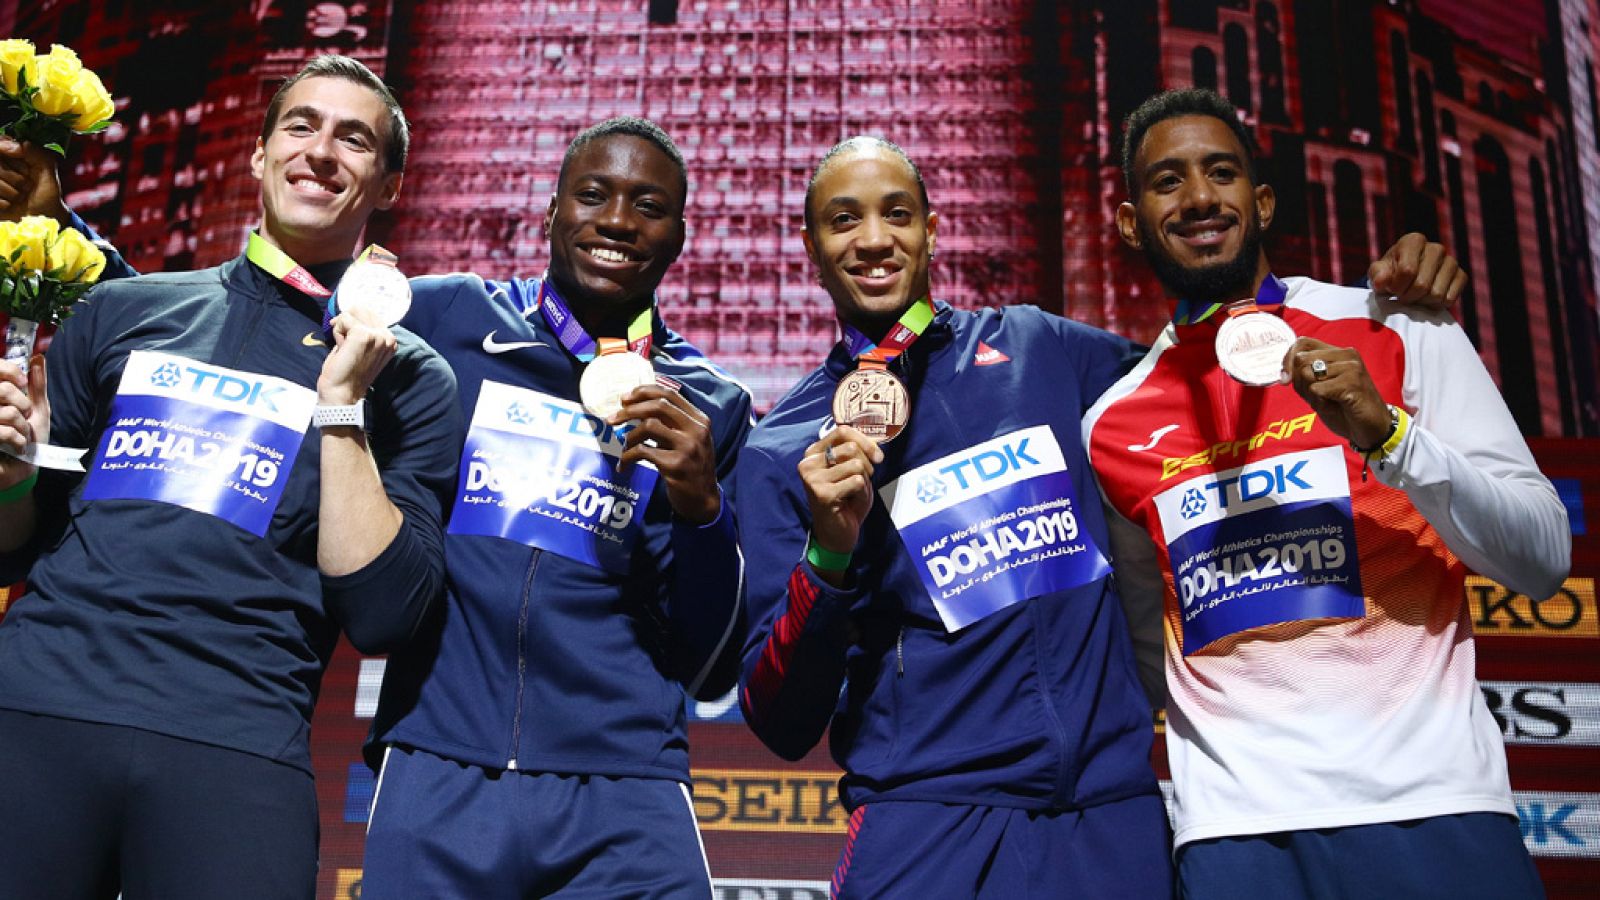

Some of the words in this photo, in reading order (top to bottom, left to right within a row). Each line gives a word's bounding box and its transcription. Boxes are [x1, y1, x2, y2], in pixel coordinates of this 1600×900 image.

[186, 366, 288, 413] TDK
[542, 402, 637, 446] TDK
[1160, 412, 1317, 481] ESPAÑA
[105, 430, 279, 487] DOHA2019
[939, 438, 1040, 489] TDK
[1206, 461, 1313, 509] TDK
[466, 461, 634, 529] DO2019
[922, 536, 949, 557] IAAF
[950, 523, 978, 543] World
[979, 511, 1016, 529] Athletics
[1016, 497, 1071, 517] Championships
[926, 510, 1078, 588] DOHA2019
[1195, 547, 1221, 563] World
[1222, 538, 1262, 554] Athletics
[1263, 525, 1343, 543] Championships
[1180, 538, 1346, 609] DOHA2019
[690, 777, 849, 825] SEIK
